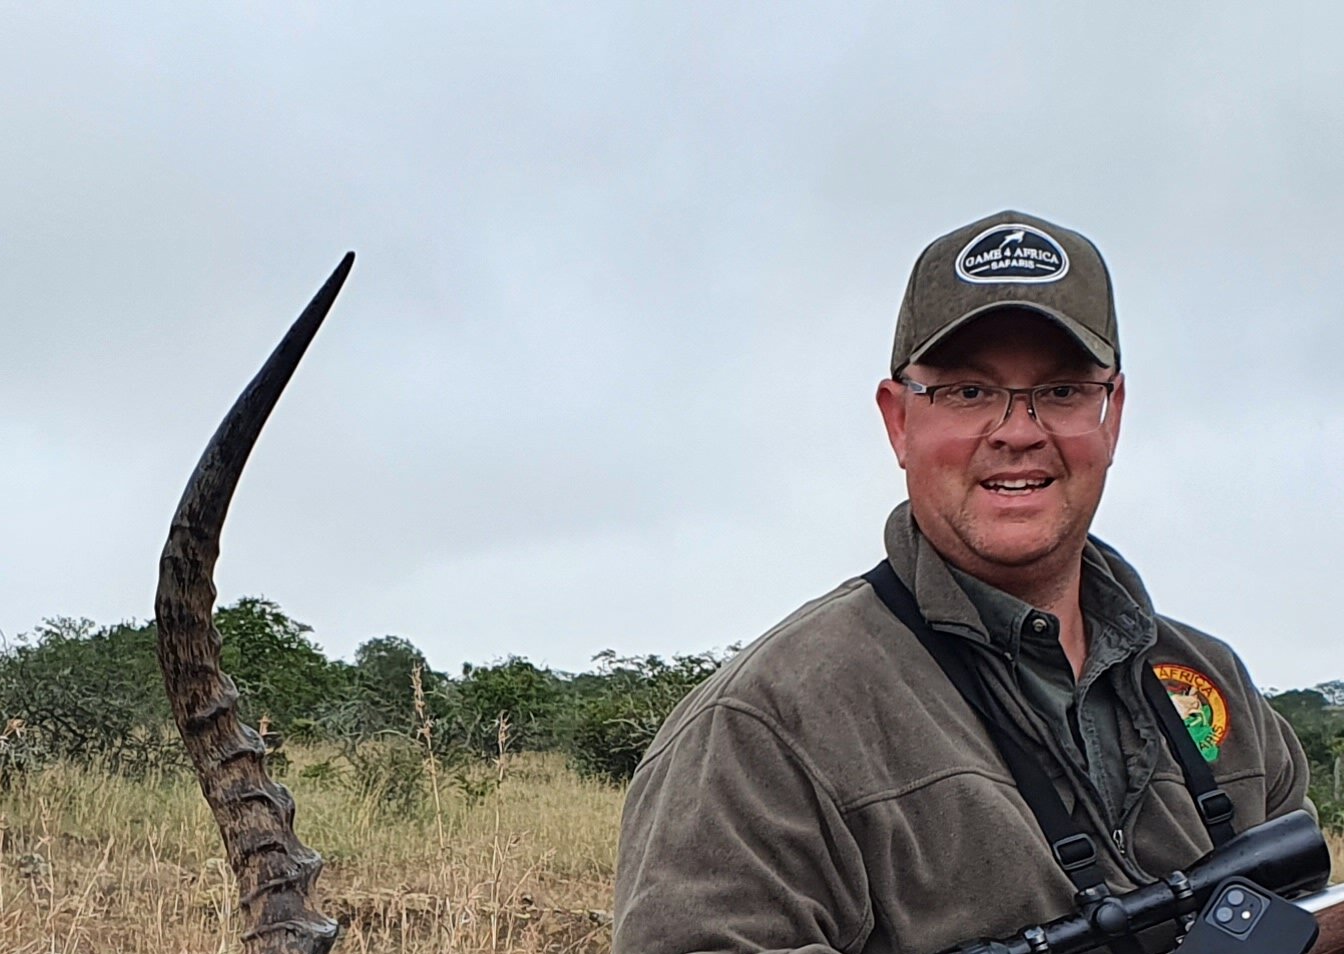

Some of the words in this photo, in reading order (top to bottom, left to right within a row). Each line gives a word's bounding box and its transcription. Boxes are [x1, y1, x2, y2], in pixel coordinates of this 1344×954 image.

[965, 249, 1002, 267] GAME
[1003, 247, 1011, 257] 4
[1014, 247, 1059, 264] AFRICA
[991, 259, 1035, 270] SAFARIS
[1159, 668, 1213, 697] AFRICA
[1199, 724, 1224, 750] ARIS
